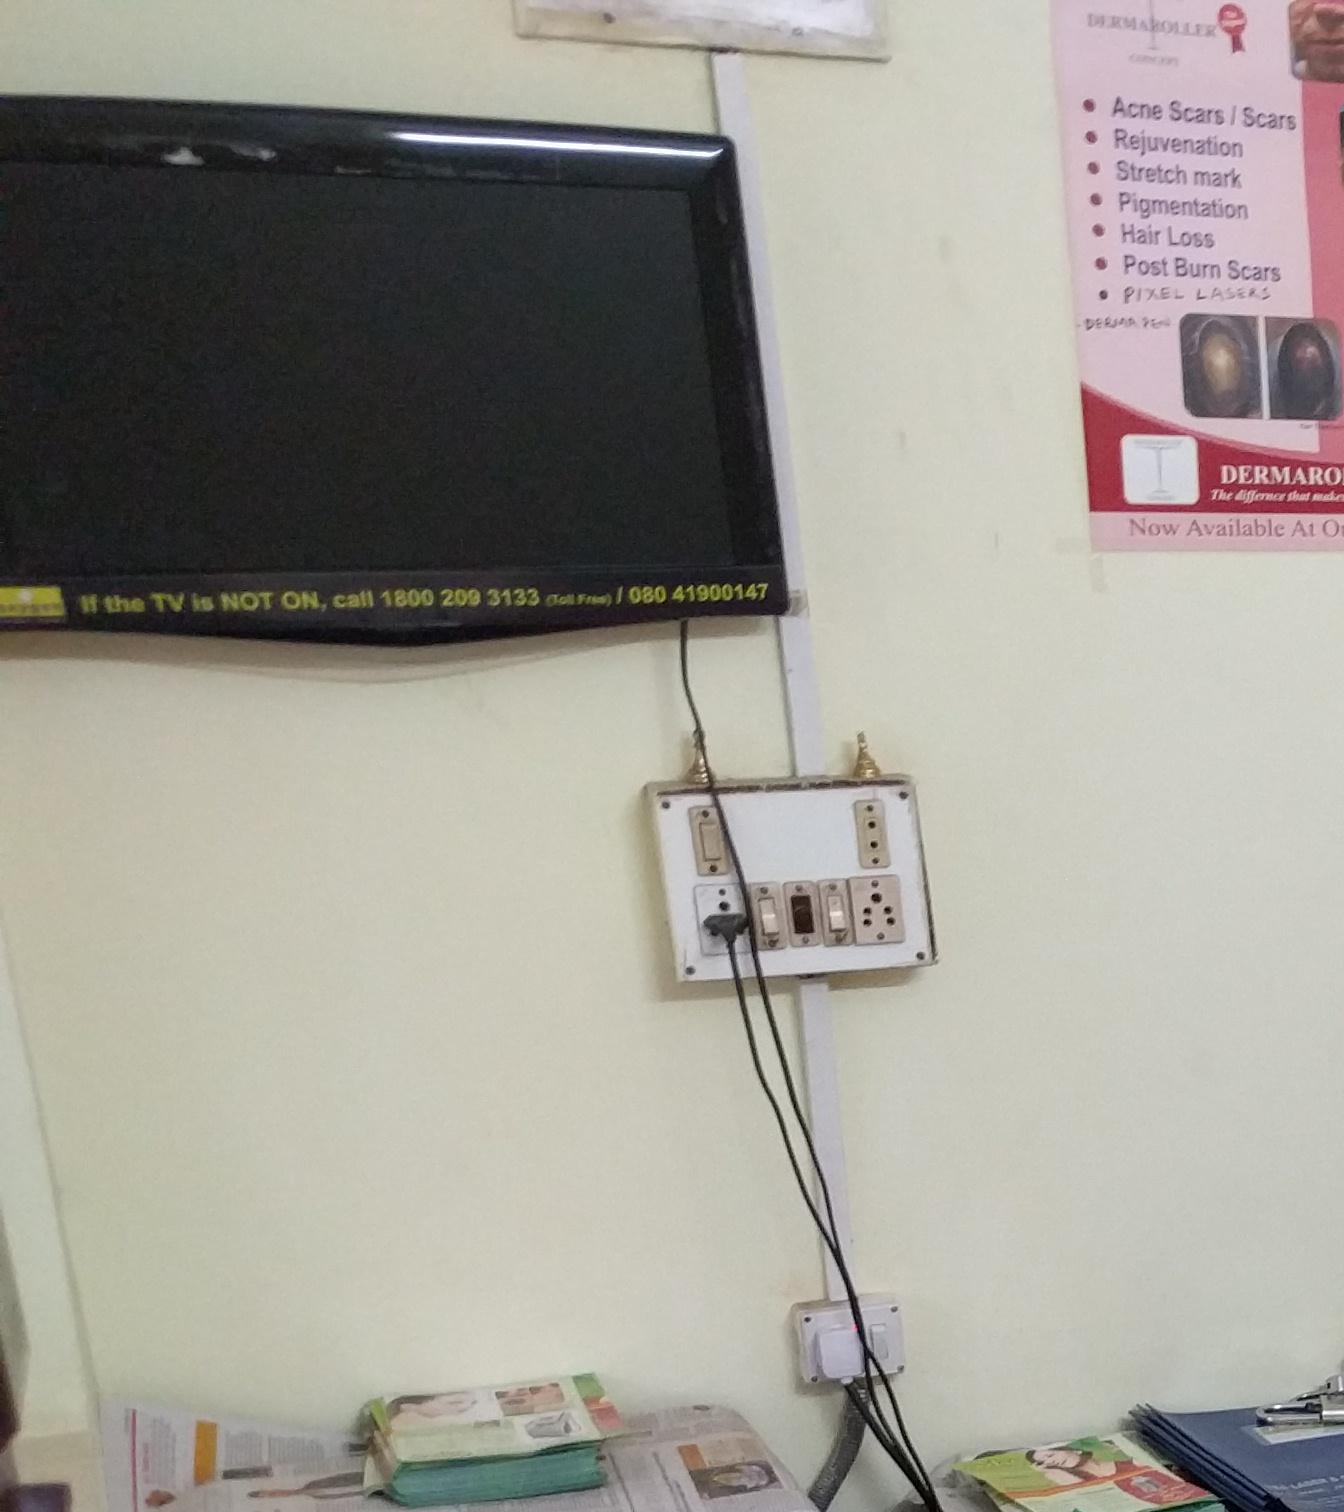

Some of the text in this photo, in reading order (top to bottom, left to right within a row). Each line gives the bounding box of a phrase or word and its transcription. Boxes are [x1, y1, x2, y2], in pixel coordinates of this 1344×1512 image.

[1111, 96, 1297, 130] Acne Scars / Scars
[1114, 128, 1244, 158] Rejuvenation
[1116, 160, 1243, 189] Stretch mark
[1118, 192, 1249, 220] Pigmentation
[1121, 223, 1215, 249] Hair Loss
[1123, 254, 1282, 282] Post Burn Scars
[1211, 488, 1233, 501] The
[1287, 490, 1310, 502] that
[1129, 517, 1180, 537] Now
[1186, 518, 1285, 538] Available
[1291, 519, 1315, 538] At
[103, 595, 145, 613] the
[151, 592, 185, 613] TV
[191, 593, 215, 613] is
[220, 591, 274, 612] NOT
[281, 590, 328, 612] ON,
[332, 590, 374, 609] call
[380, 588, 434, 608] 1800
[439, 588, 482, 608] 209
[486, 588, 540, 608] 3133
[629, 585, 667, 604] 080
[672, 583, 769, 602] 41900147
